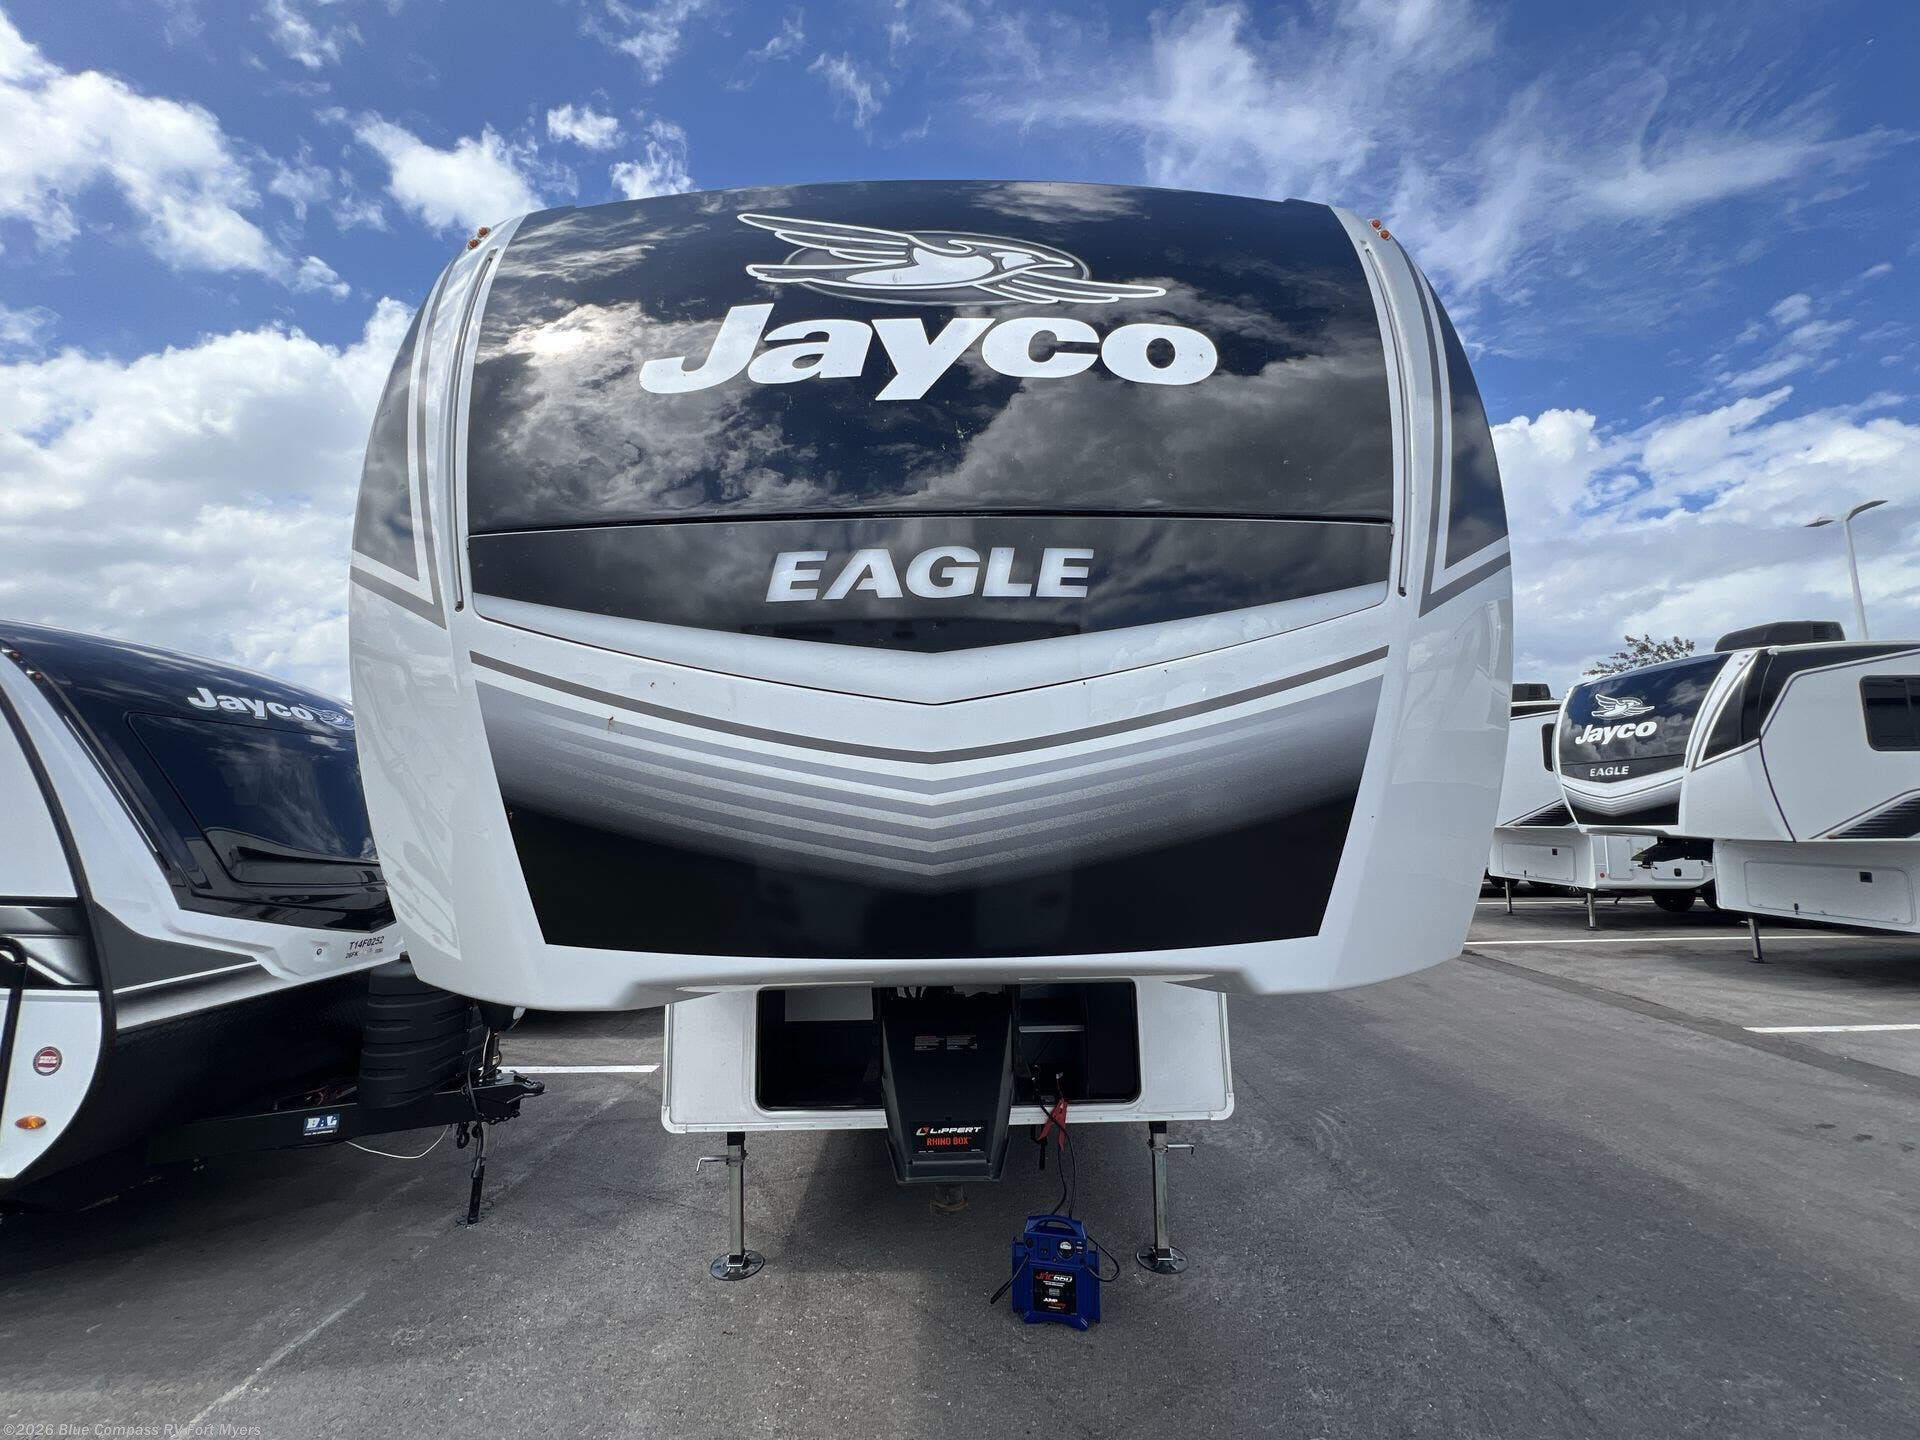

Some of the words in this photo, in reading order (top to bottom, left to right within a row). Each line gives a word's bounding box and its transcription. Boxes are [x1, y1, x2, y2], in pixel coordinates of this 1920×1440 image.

[638, 302, 1219, 402] Jayco
[765, 545, 1095, 603] EAGLE
[187, 687, 314, 721] Jayco
[1574, 721, 1658, 745] Jayco
[1589, 765, 1630, 777] EAGLE
[926, 1136, 951, 1146] RHINO
[953, 1136, 969, 1145] BOX
